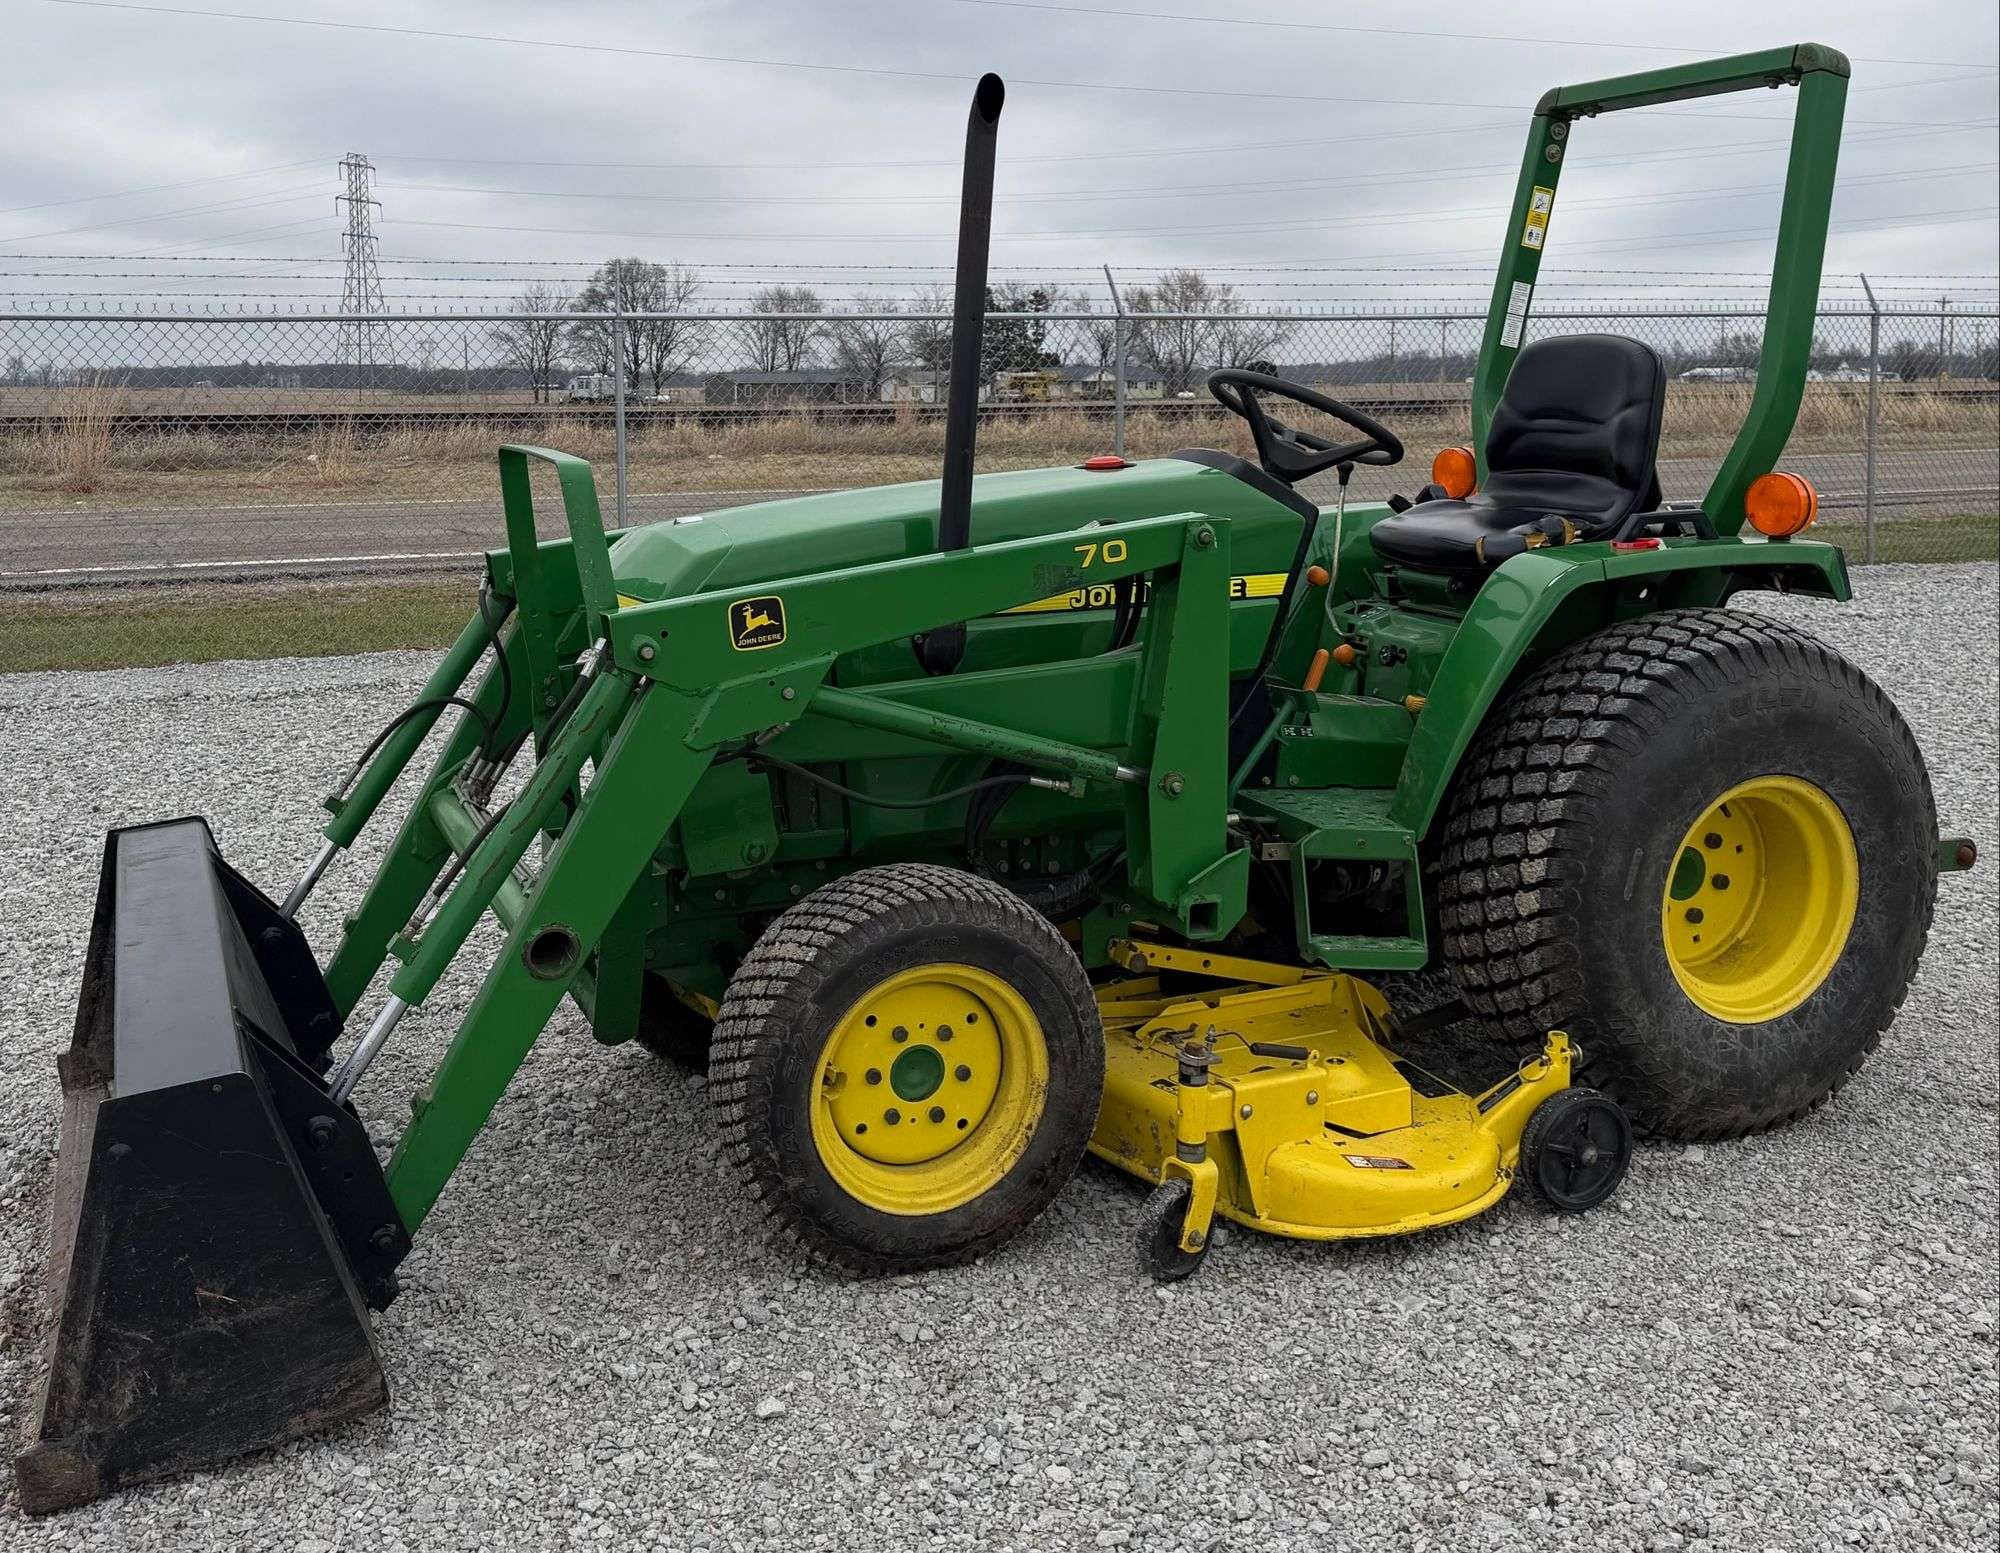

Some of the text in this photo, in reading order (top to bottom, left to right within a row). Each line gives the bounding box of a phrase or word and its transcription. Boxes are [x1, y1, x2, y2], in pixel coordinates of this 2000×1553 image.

[1074, 539, 1128, 568] 70
[737, 633, 782, 646] JOHN DEERE
